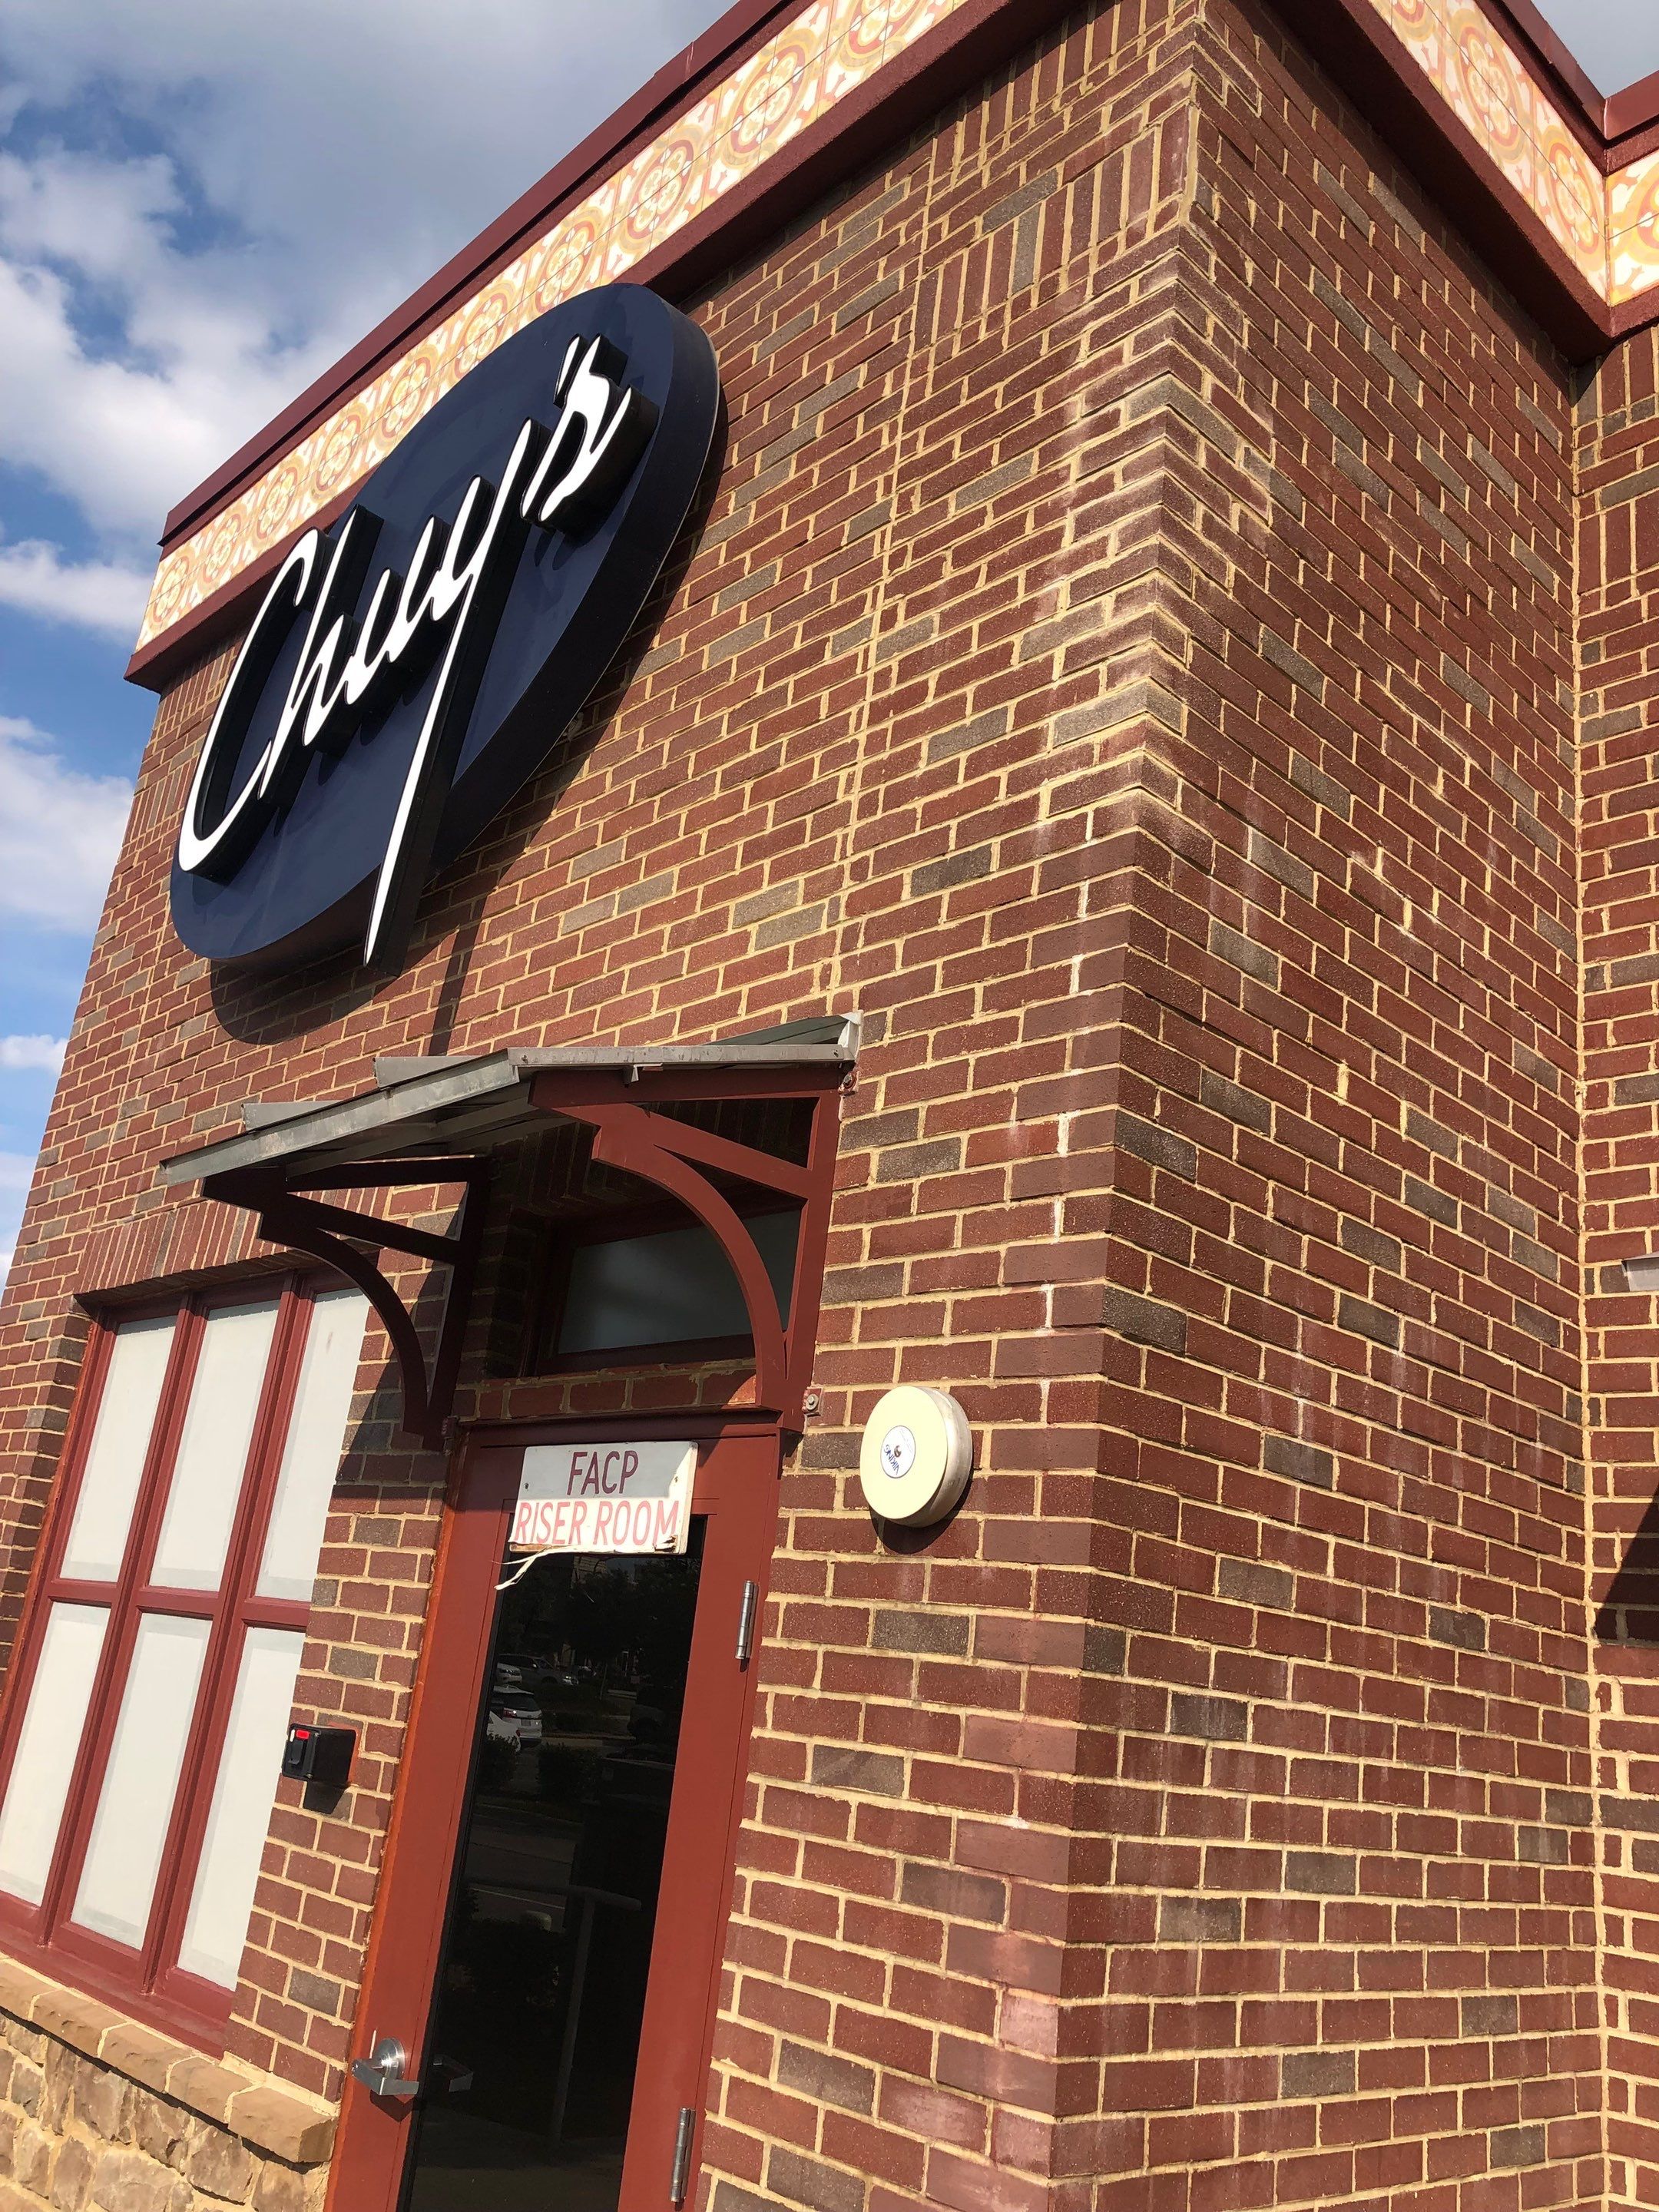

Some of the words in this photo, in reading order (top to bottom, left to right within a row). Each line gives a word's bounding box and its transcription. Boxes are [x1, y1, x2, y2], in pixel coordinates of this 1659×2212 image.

[179, 334, 631, 967] Chuy's
[567, 1451, 639, 1495] FACP
[884, 1444, 899, 1475] VIKING
[514, 1502, 588, 1545] RISER
[593, 1500, 679, 1546] ROOM
